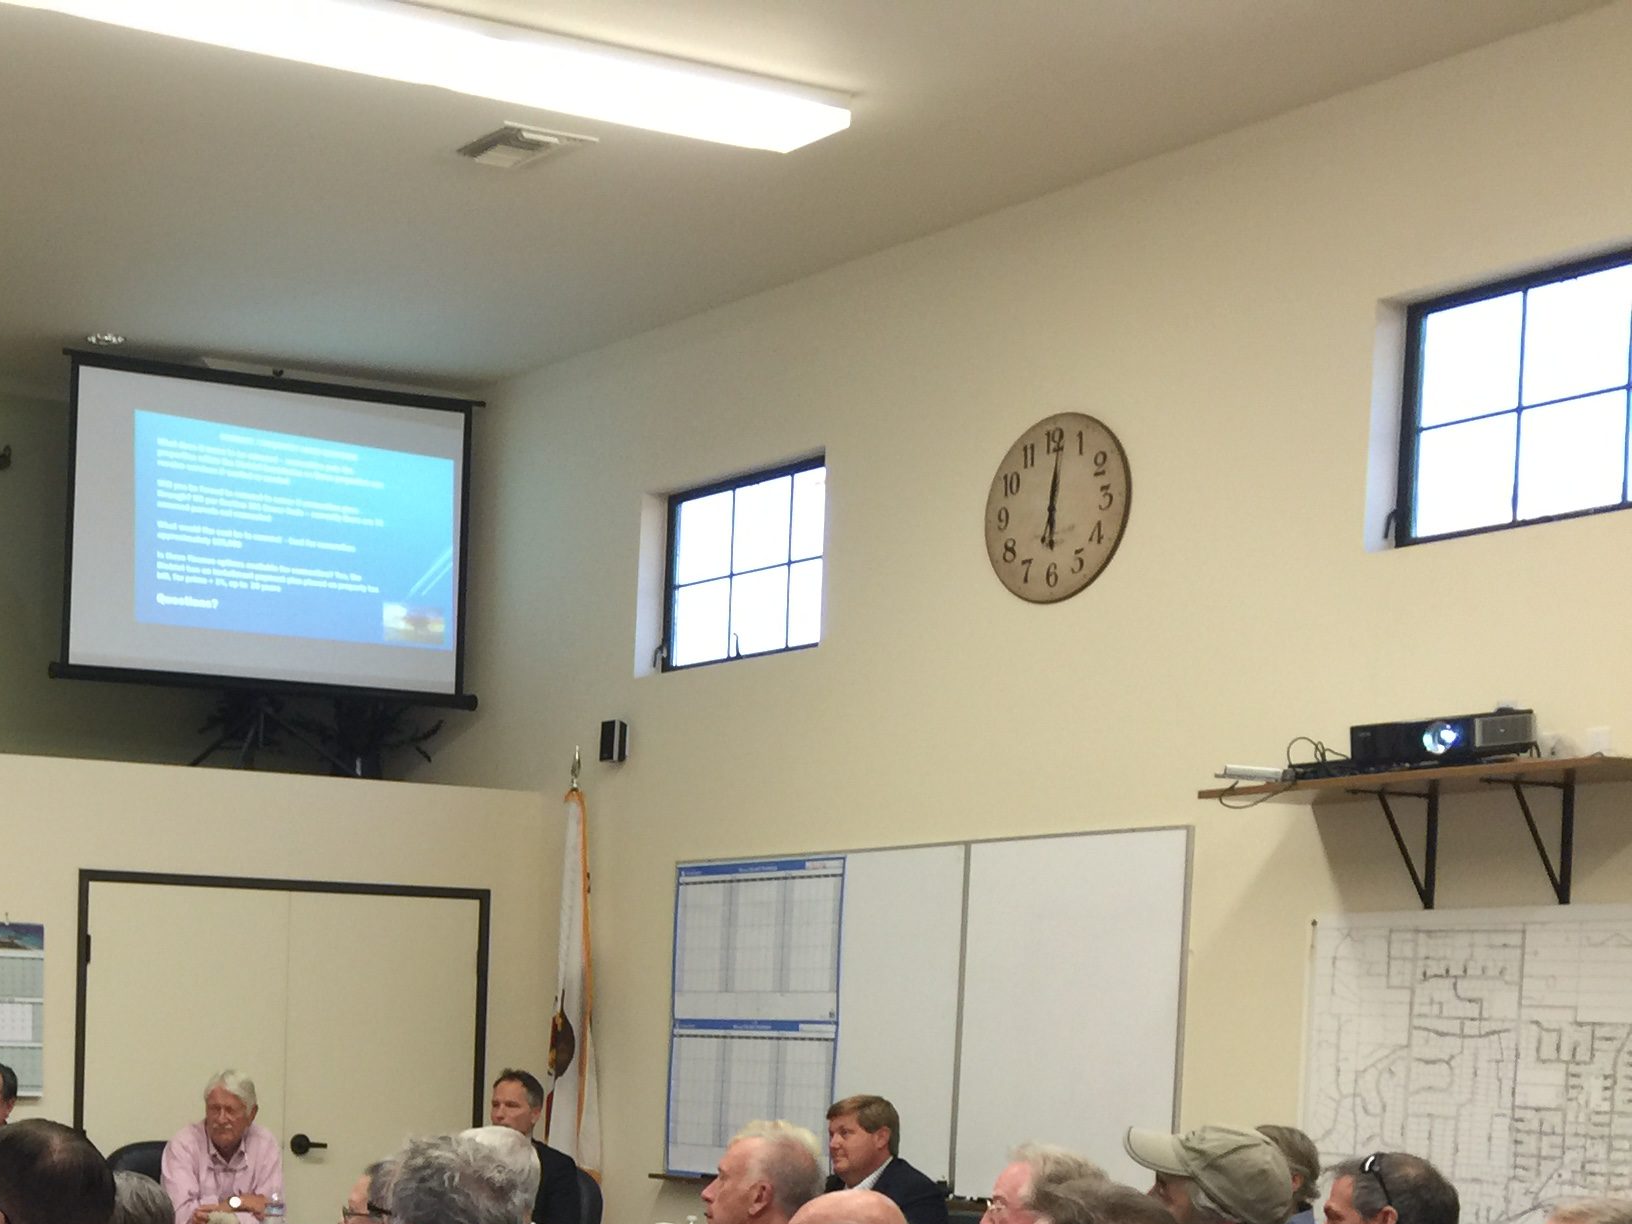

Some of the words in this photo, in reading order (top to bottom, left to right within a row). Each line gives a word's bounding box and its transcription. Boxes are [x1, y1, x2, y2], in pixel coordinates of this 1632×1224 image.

[1045, 427, 1064, 455] 12
[1076, 431, 1083, 455] 1
[1023, 443, 1035, 469] 11
[1094, 451, 1107, 477] 2
[1003, 472, 1020, 497] 10
[1099, 484, 1113, 511] 3
[997, 507, 1009, 531] 9
[1088, 520, 1104, 545] 4
[1002, 538, 1016, 564] 8
[1071, 548, 1085, 574] 5
[1021, 558, 1033, 584] 7
[1046, 563, 1058, 588] 6
